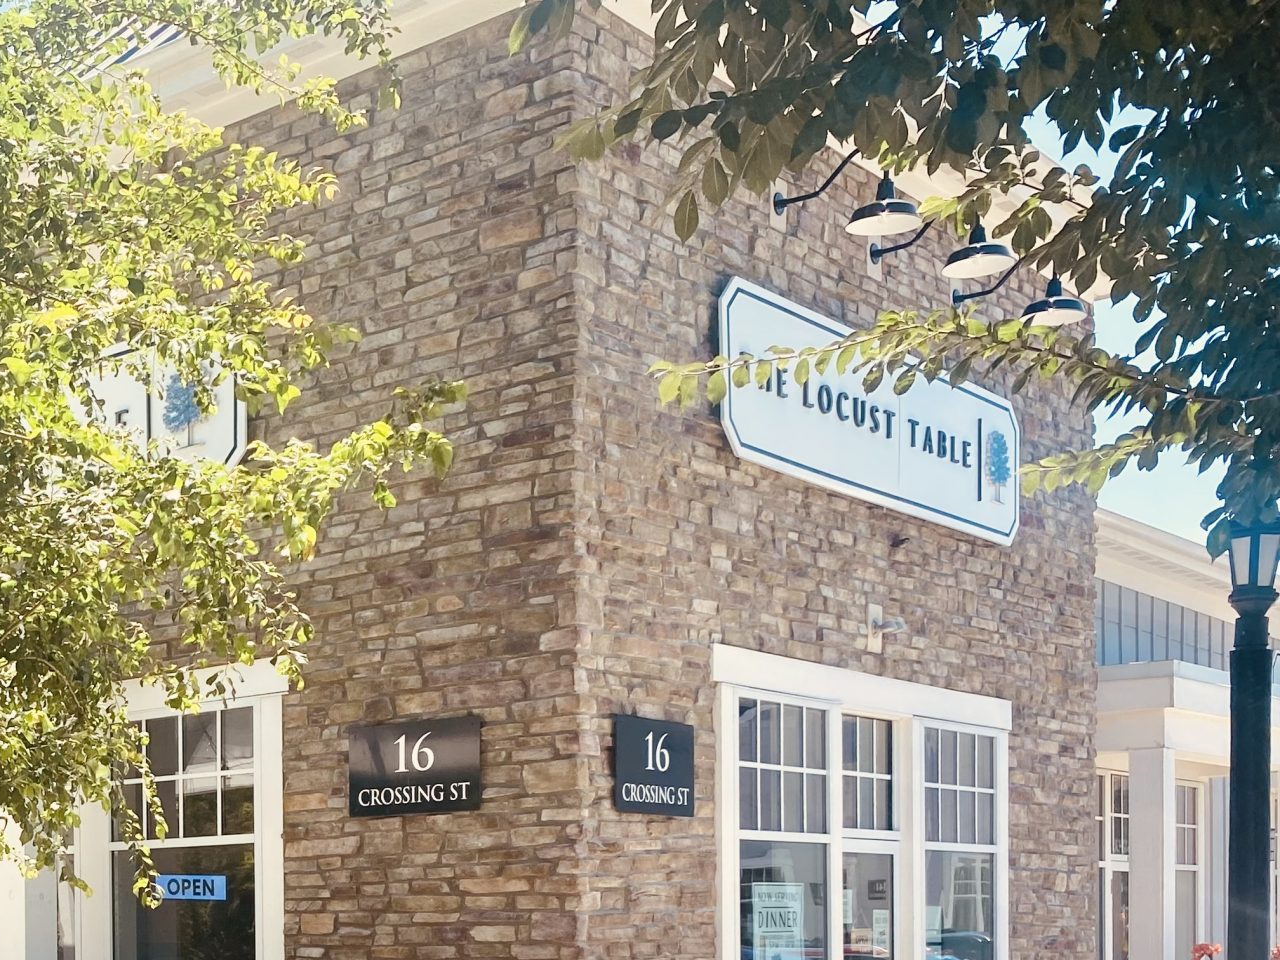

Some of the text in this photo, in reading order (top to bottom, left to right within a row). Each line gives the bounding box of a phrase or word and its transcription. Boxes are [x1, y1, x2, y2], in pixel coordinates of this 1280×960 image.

[803, 376, 972, 468] LOCUST TABLE
[394, 731, 435, 773] 16
[645, 731, 669, 772] 16
[358, 782, 470, 807] CROSSING ST
[622, 783, 689, 806] CROSSING ST
[167, 878, 215, 896] OPEN
[758, 911, 797, 929] DINNER
